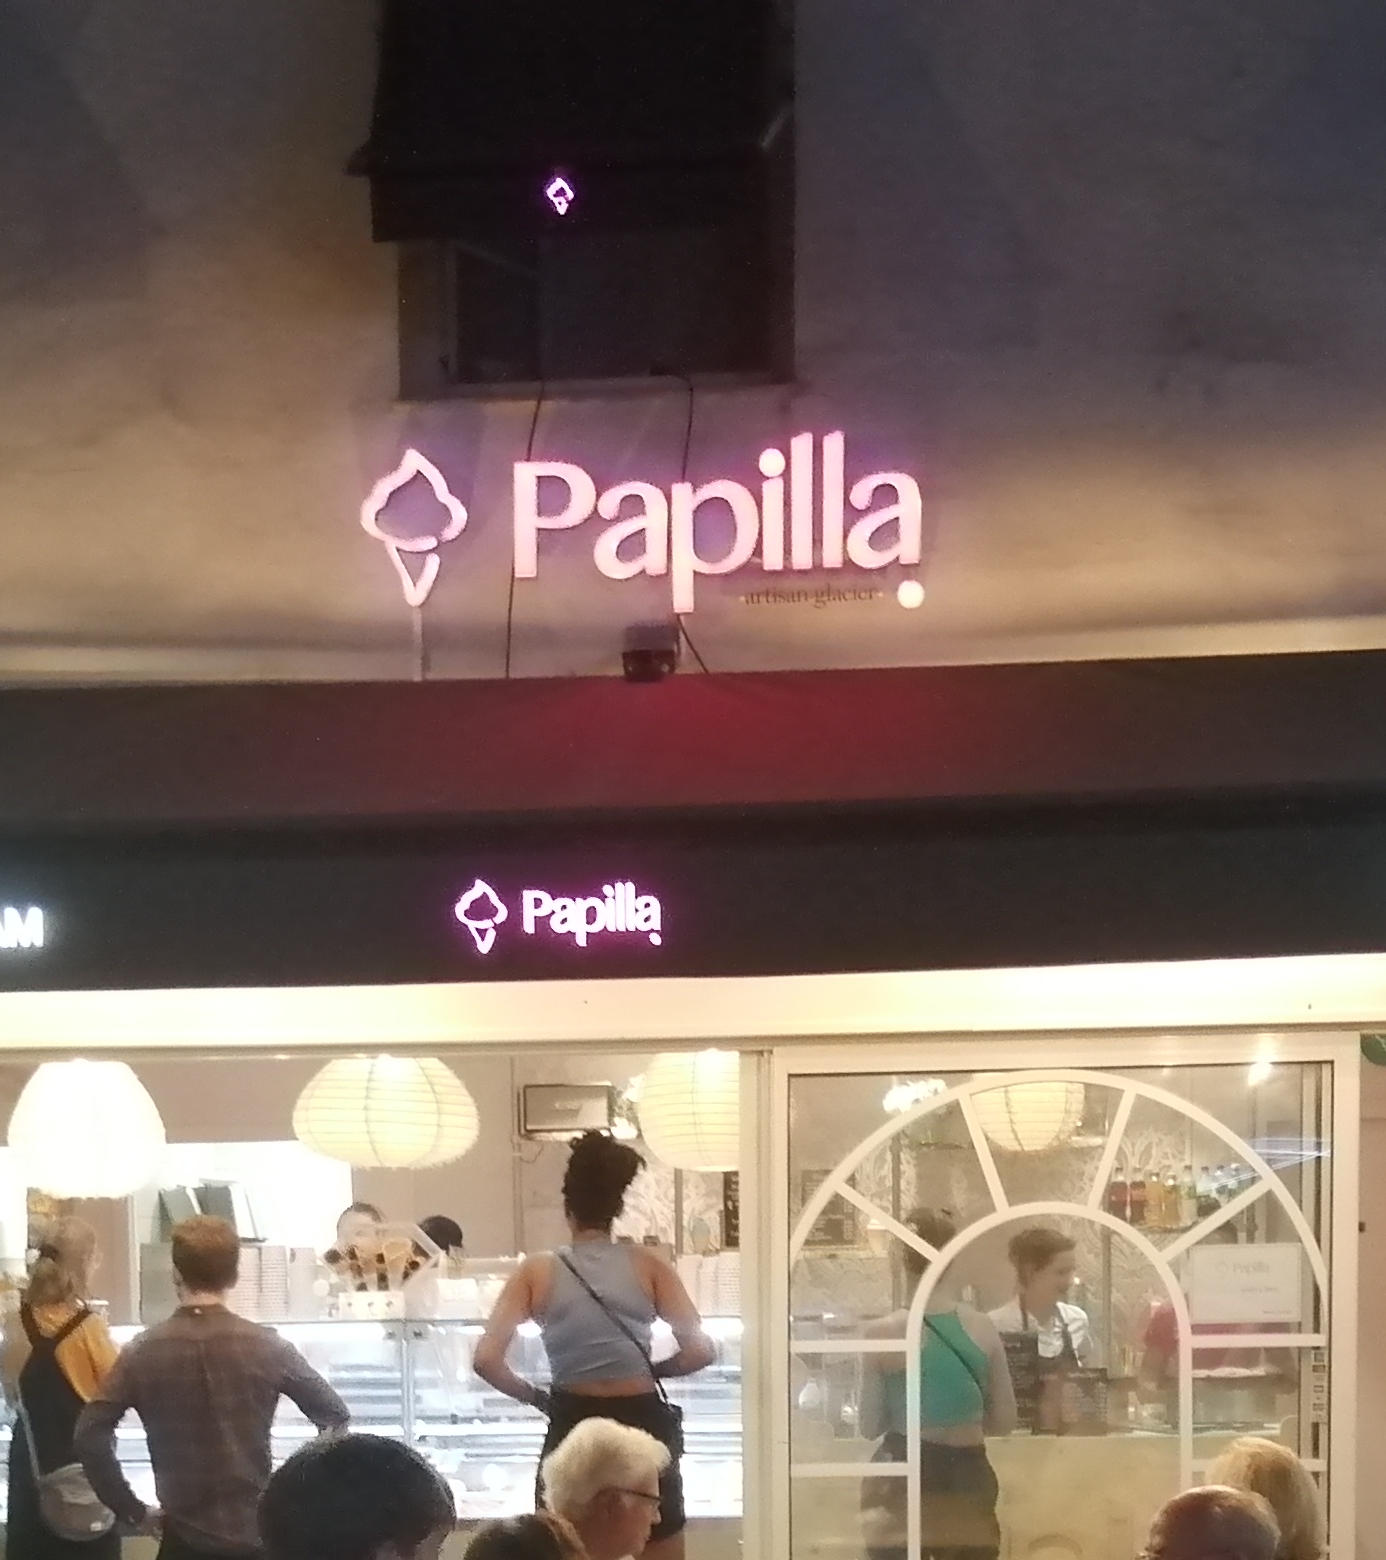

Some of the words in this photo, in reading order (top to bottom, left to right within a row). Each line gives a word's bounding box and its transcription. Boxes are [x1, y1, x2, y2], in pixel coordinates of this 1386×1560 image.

[514, 430, 922, 613] Papilla
[745, 586, 808, 606] artisan
[812, 583, 878, 609] glacier
[522, 881, 662, 947] Papilla
